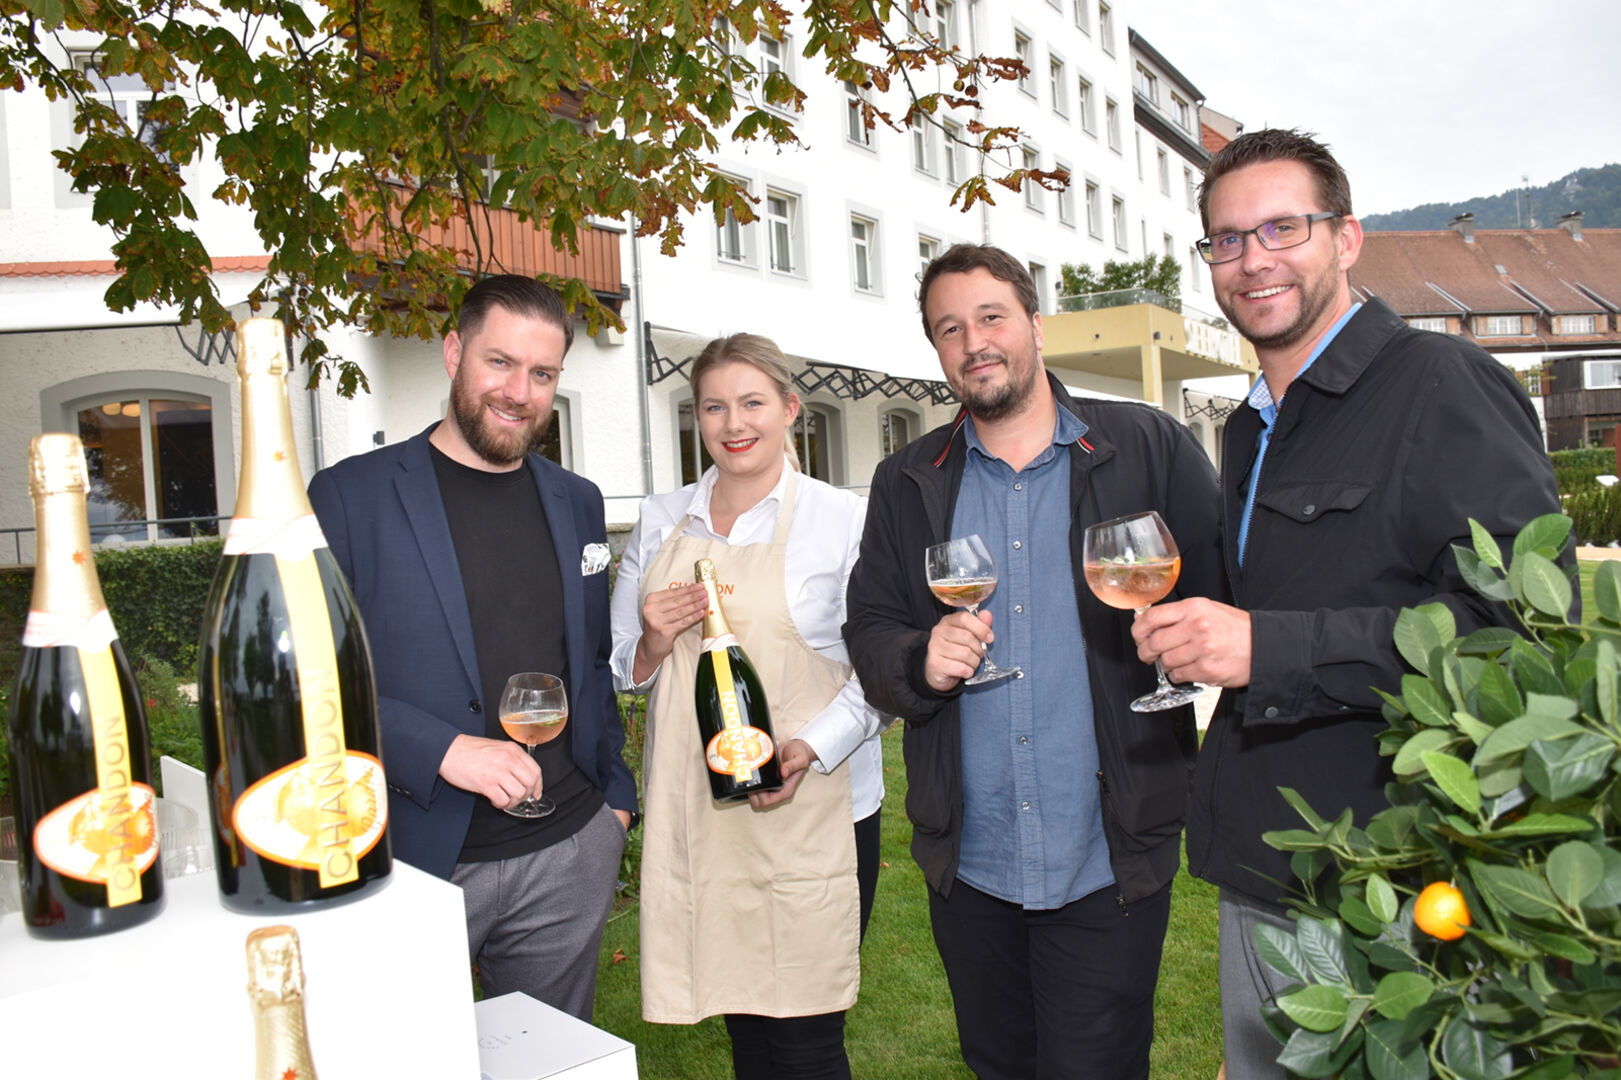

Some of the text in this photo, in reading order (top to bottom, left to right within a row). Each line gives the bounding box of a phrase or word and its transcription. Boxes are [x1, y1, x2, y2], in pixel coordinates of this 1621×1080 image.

[668, 581, 734, 596] CHON
[306, 668, 353, 879] CHANDON
[721, 690, 750, 779] CHANDON
[102, 714, 136, 891] CHANDON
